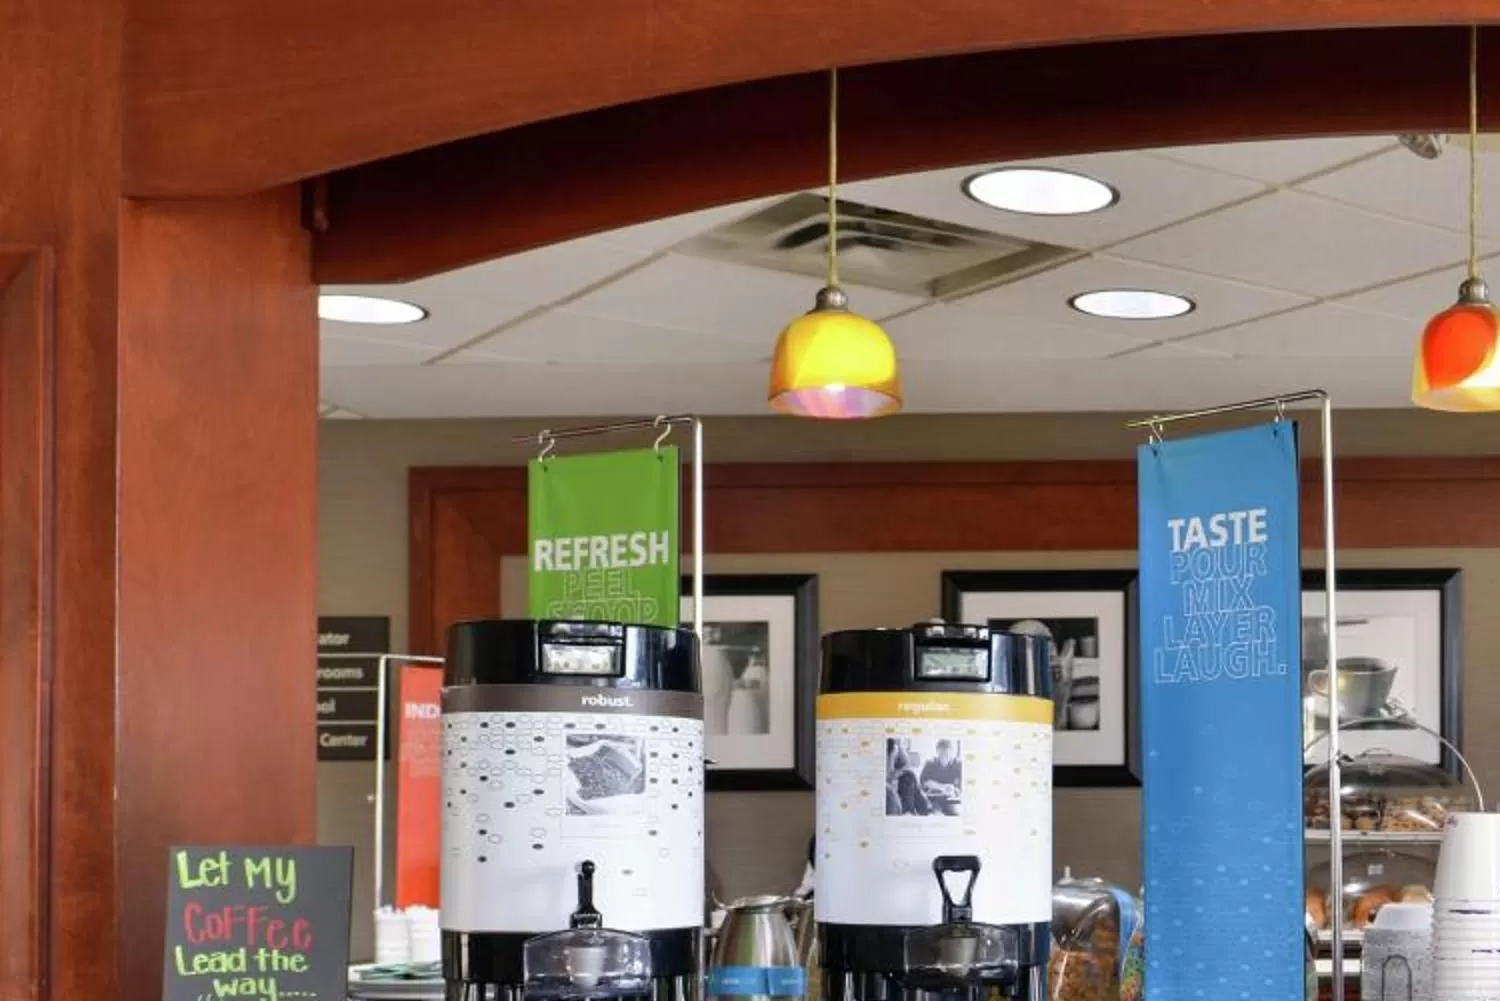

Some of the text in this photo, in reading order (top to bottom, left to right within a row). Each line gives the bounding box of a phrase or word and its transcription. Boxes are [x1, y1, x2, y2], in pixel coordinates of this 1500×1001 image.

[534, 529, 669, 572] REFRESH
[1168, 508, 1268, 552] TASTE
[563, 567, 640, 600] PEEL
[1170, 543, 1268, 584] POUR
[1183, 575, 1255, 617] MIX
[1163, 604, 1277, 651] LAYER
[1153, 639, 1288, 684] LAUGH.
[320, 732, 368, 747] Center
[176, 850, 296, 905] Let My
[174, 945, 310, 977] Lead the
